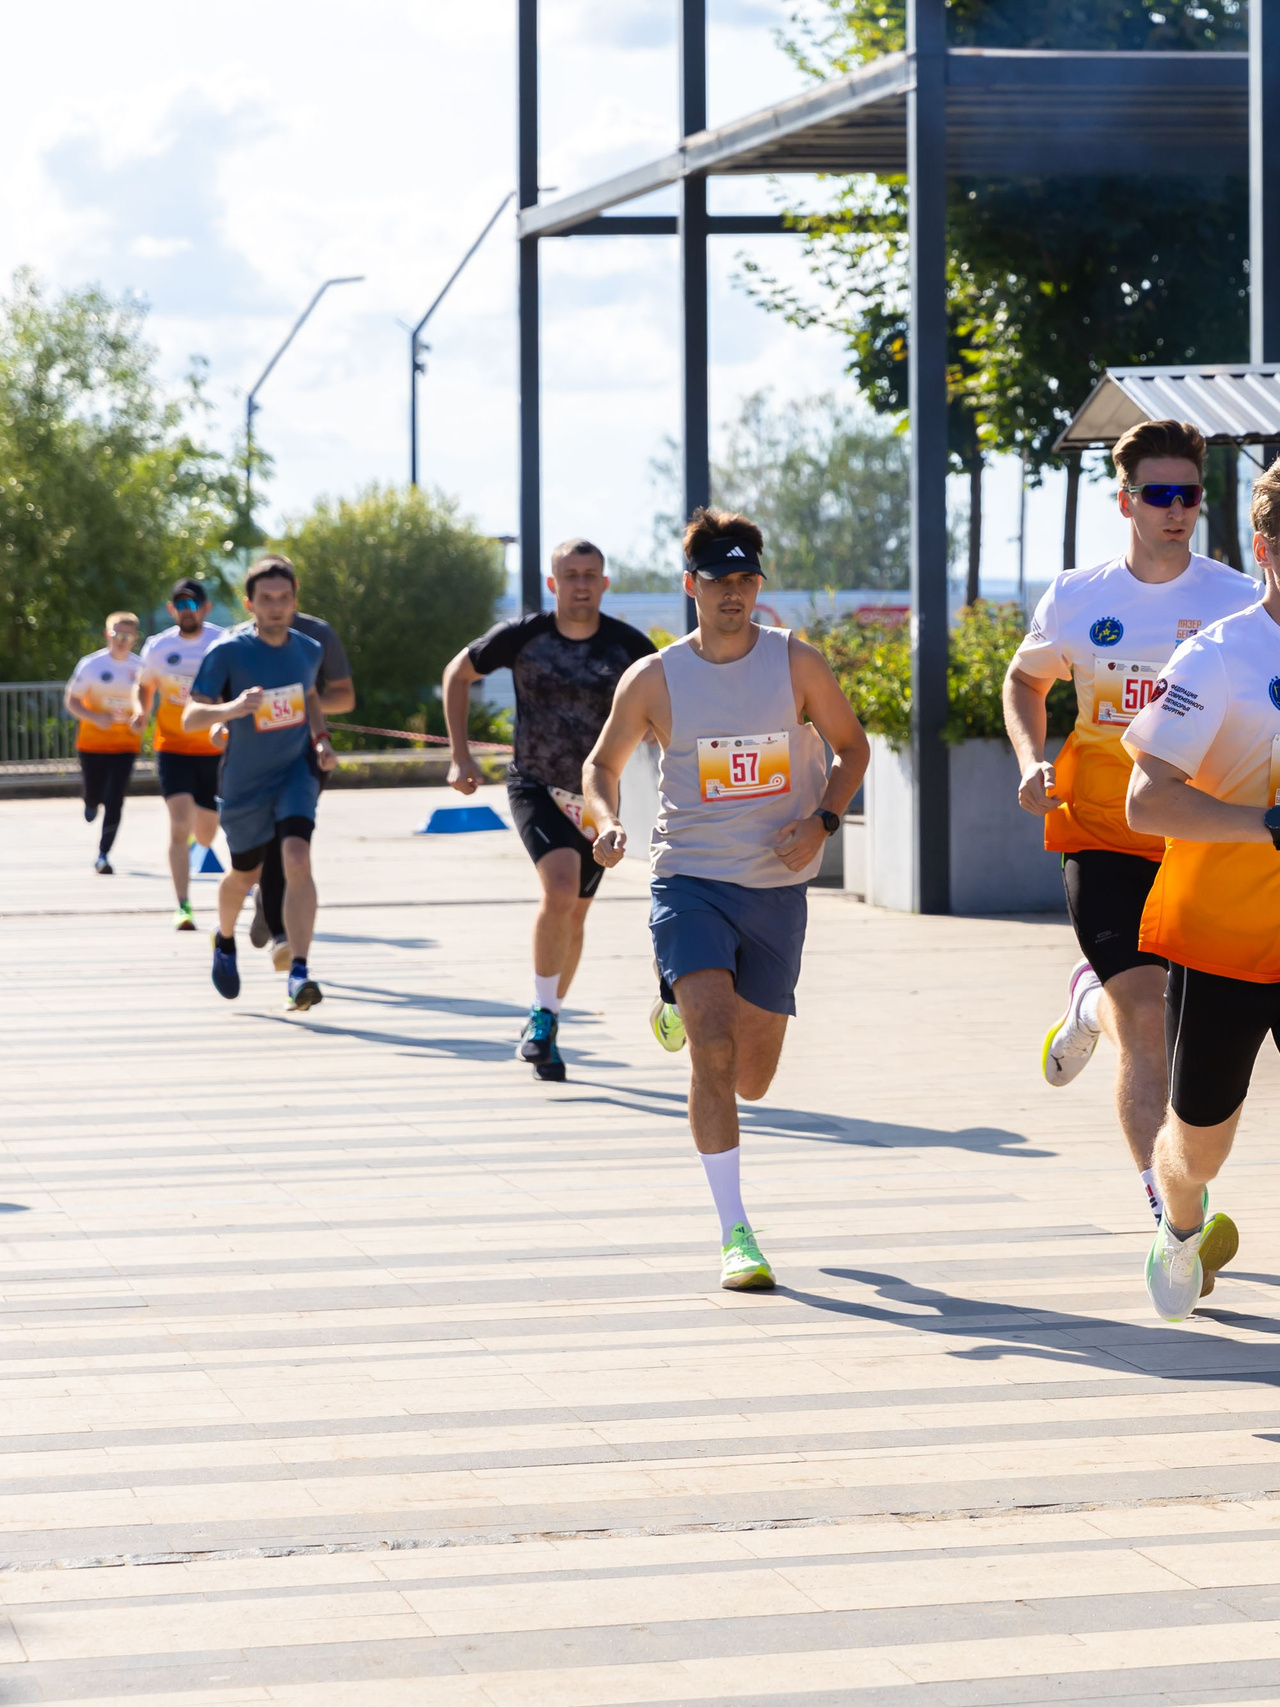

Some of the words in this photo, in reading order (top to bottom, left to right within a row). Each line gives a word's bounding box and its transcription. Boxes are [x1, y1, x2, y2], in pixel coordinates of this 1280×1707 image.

[1125, 678, 1154, 710] 50
[1168, 691, 1204, 711] СОВРЕМЕННОГО
[1171, 684, 1198, 699] ФЕДЕРАЦИЯ
[272, 698, 291, 718] 54
[732, 752, 759, 783] 57
